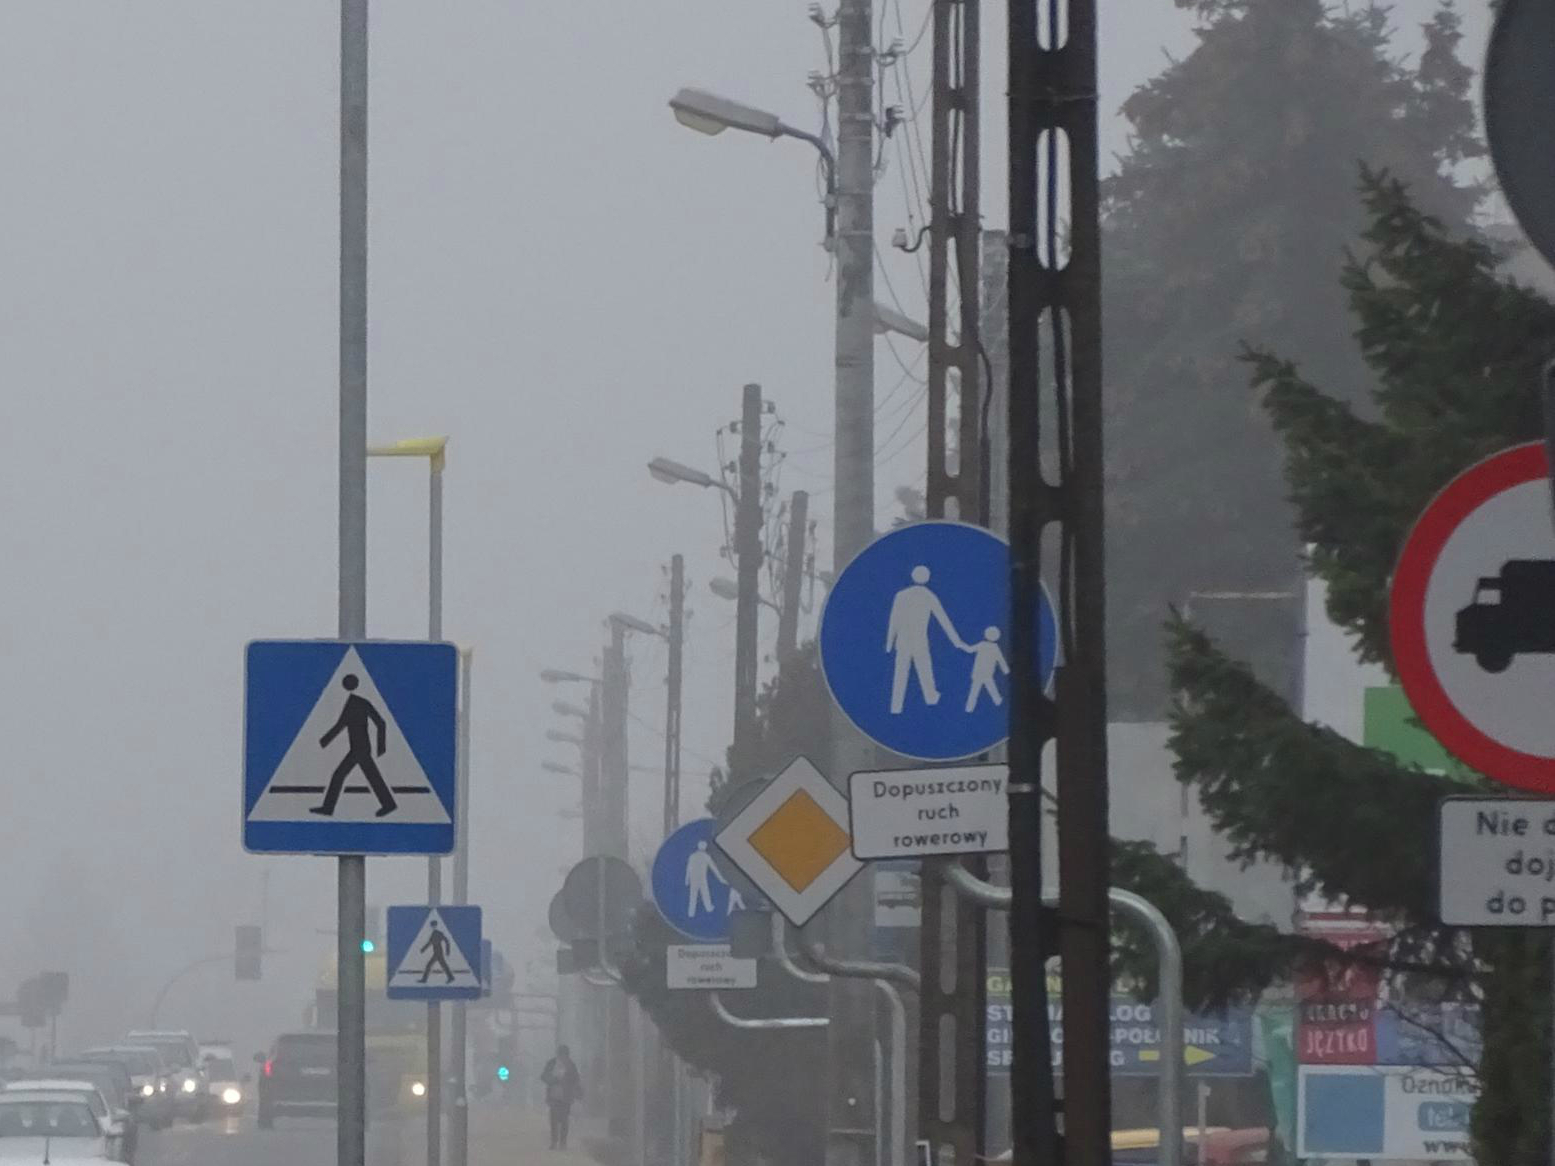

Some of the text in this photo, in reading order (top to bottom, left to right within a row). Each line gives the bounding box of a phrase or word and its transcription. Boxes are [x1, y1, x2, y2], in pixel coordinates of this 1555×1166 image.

[872, 778, 1002, 800] Dopuszczony
[917, 803, 960, 821] ruch
[1476, 810, 1529, 836] Nie
[893, 830, 988, 848] rowerowy
[1487, 890, 1526, 914] do
